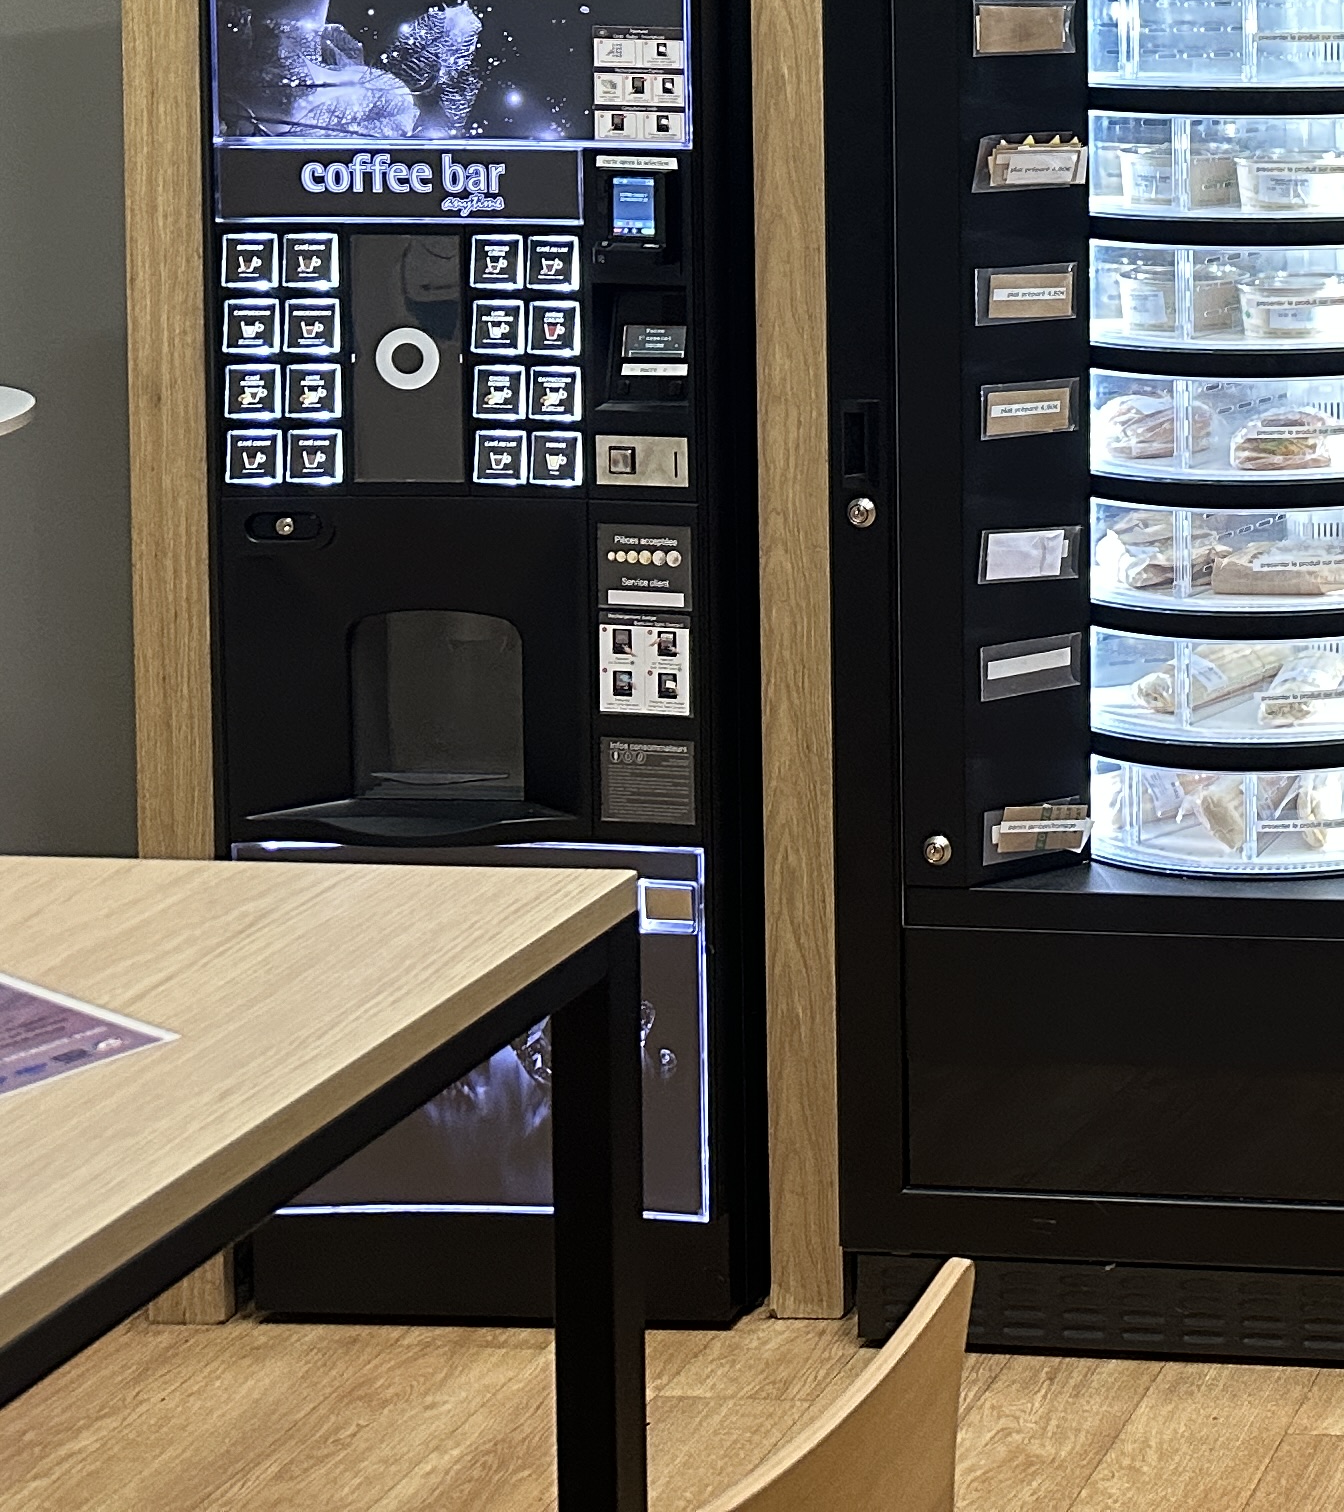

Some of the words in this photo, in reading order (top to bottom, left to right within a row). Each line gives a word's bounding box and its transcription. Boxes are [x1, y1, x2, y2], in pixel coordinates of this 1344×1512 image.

[301, 153, 433, 193] coffee
[441, 153, 506, 193] bar
[1294, 165, 1316, 173] produit
[441, 192, 505, 217] anytime
[614, 535, 639, 546] Pièces
[640, 537, 678, 547] acceptées
[621, 577, 648, 587] Service
[650, 578, 670, 588] client
[610, 741, 628, 751] Infos
[630, 742, 687, 753] consommateurs
